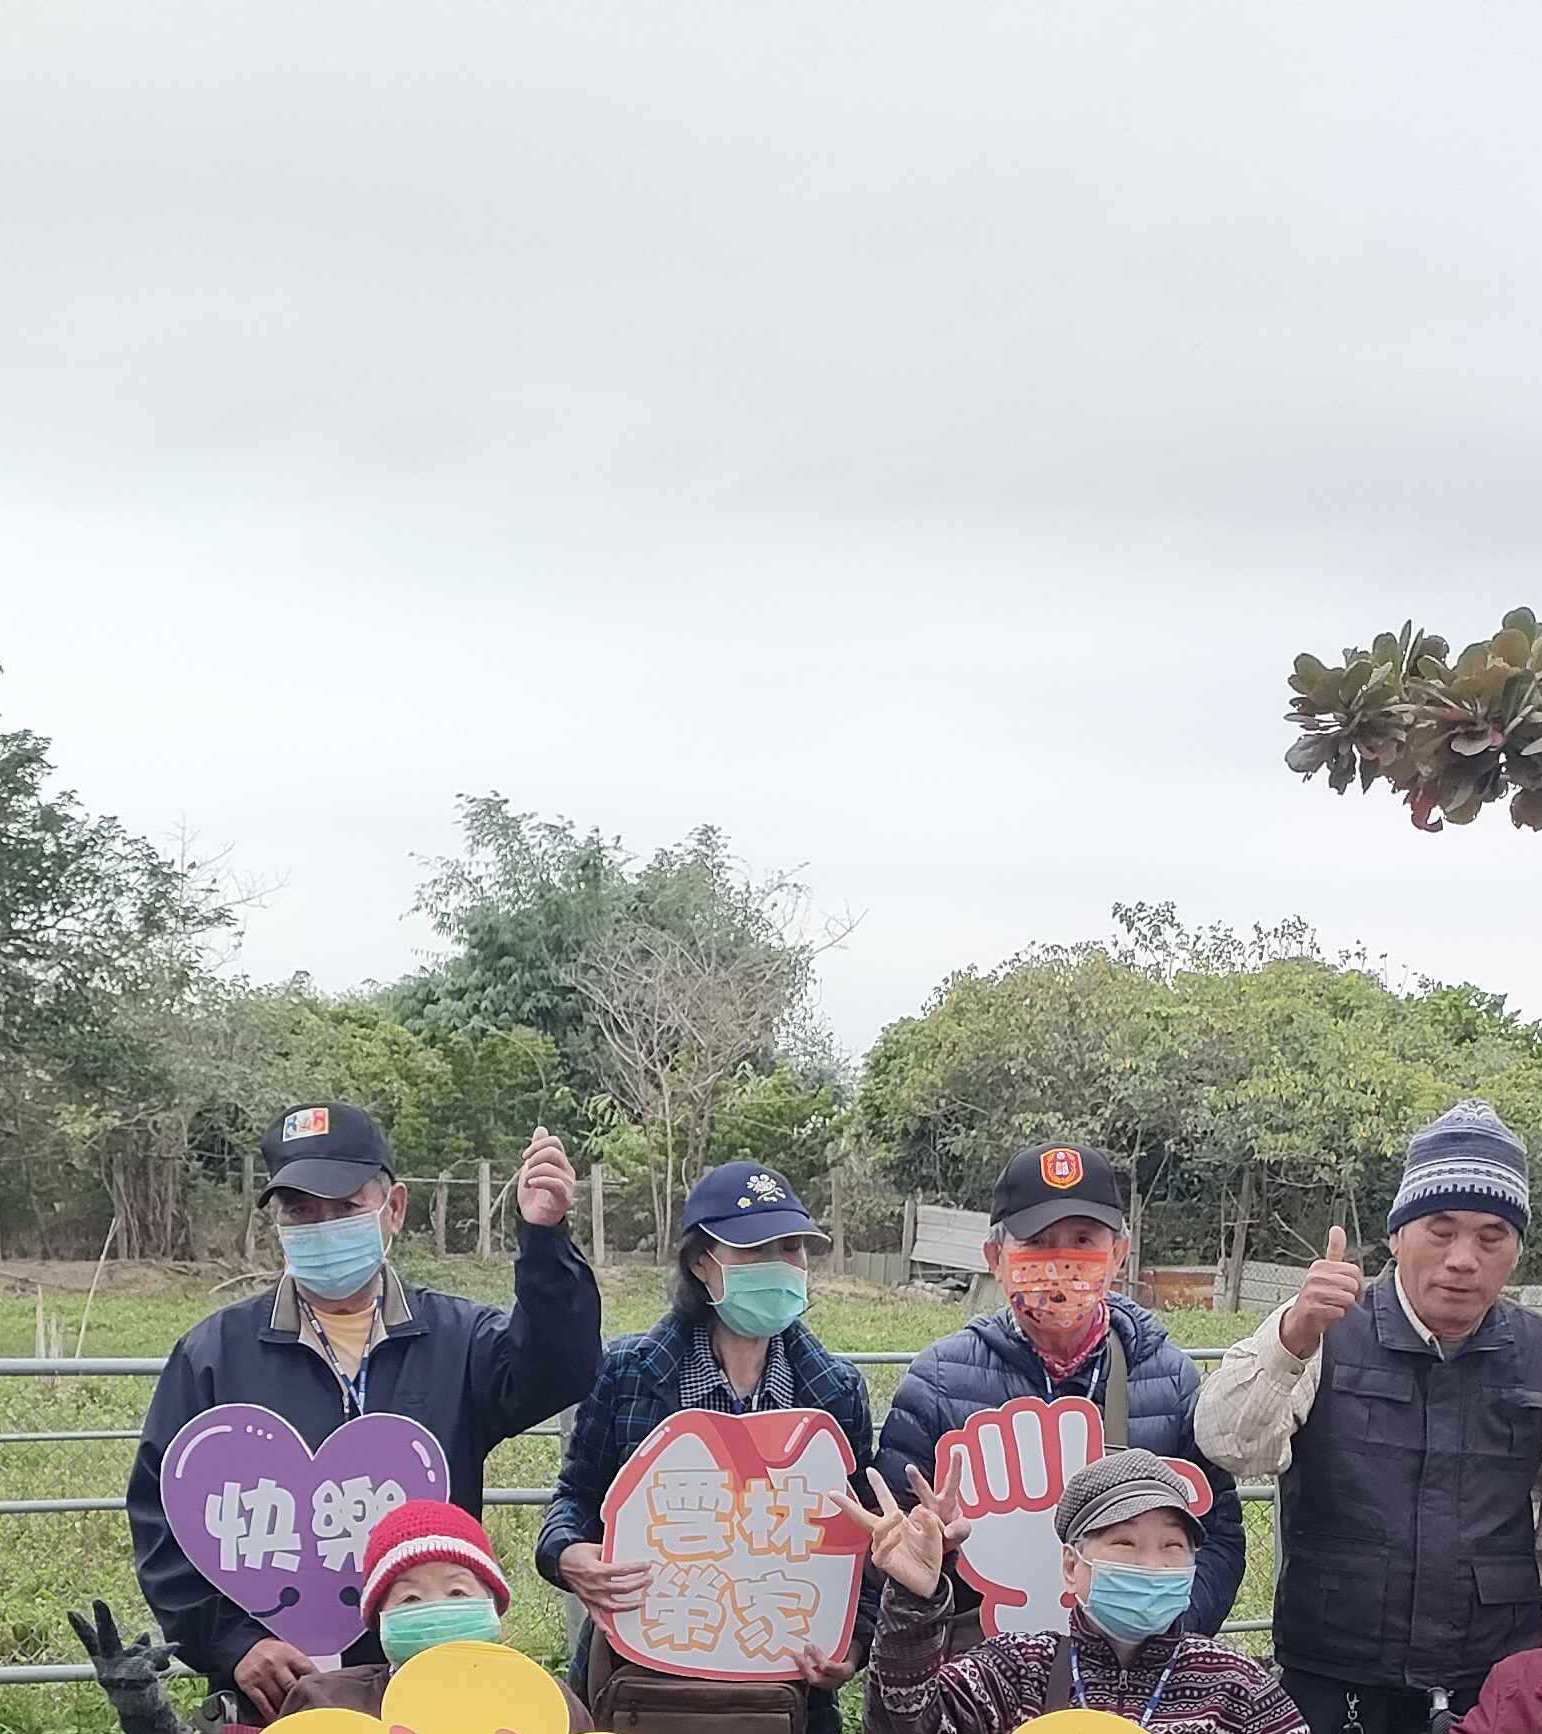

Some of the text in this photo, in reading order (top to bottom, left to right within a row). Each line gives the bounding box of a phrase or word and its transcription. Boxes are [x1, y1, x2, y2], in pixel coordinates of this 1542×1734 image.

[204, 1475, 407, 1573] 快樂
[646, 1469, 826, 1563] 雲林
[640, 1560, 821, 1662] 榮家
